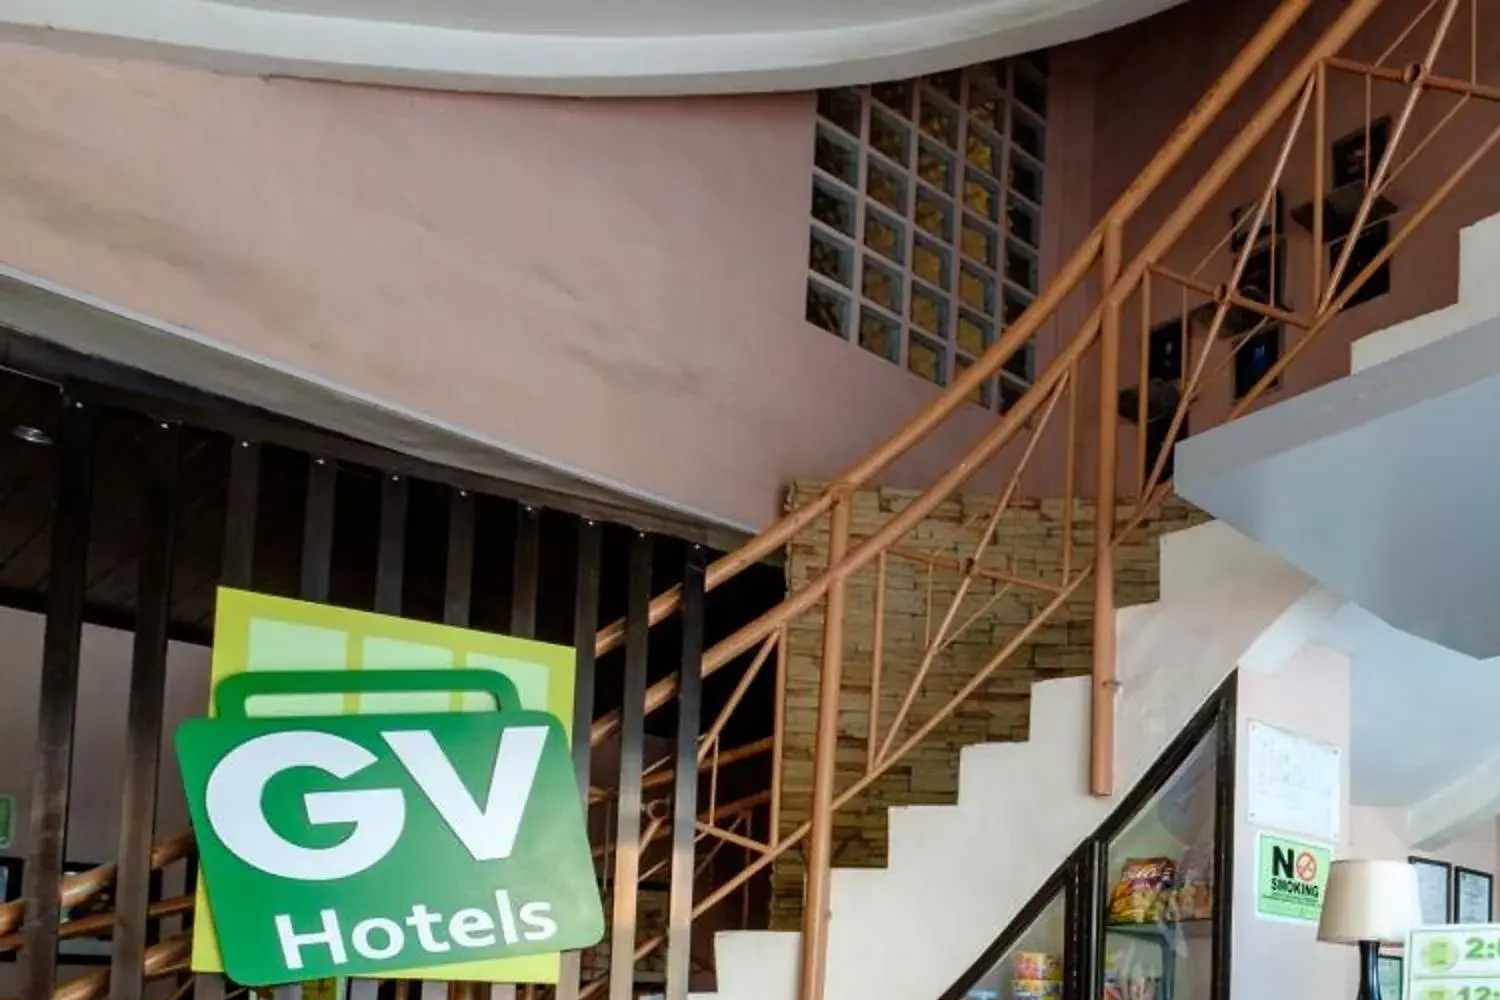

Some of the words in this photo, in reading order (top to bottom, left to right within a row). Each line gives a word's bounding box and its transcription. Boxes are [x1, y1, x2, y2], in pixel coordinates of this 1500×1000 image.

[206, 726, 549, 880] GV
[1271, 878, 1319, 898] SMOKING
[274, 890, 557, 970] Hotels
